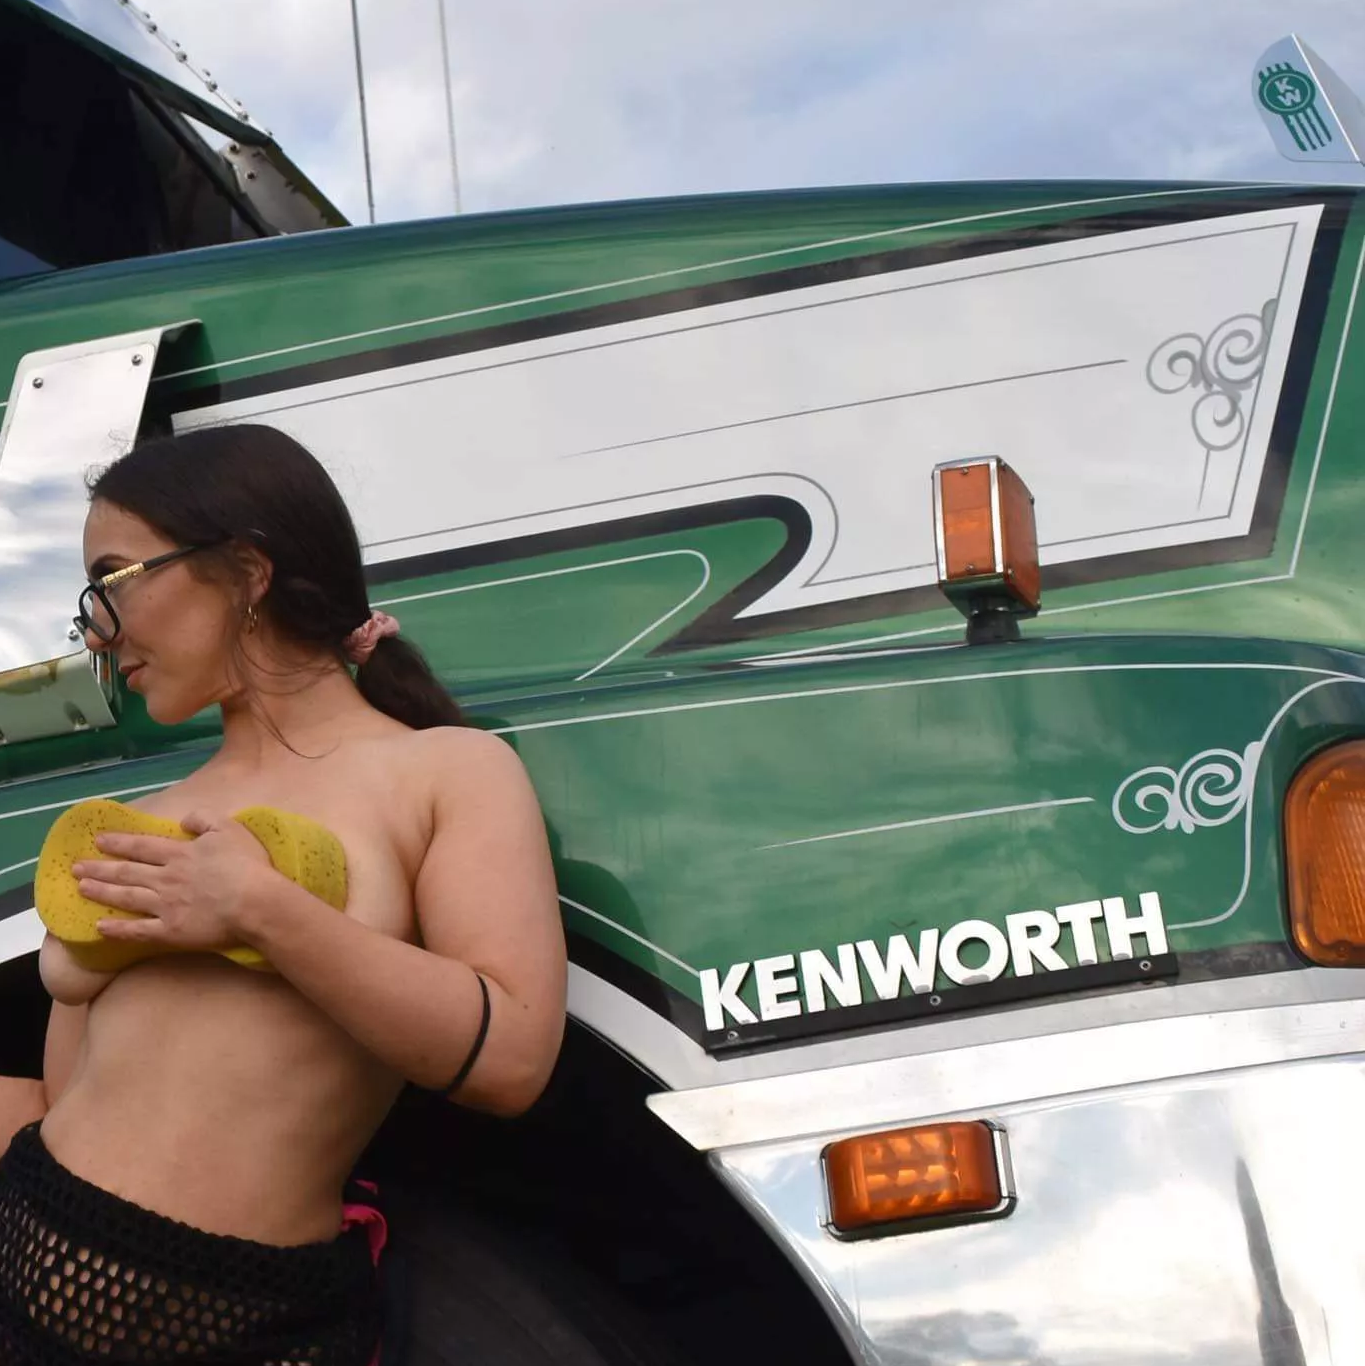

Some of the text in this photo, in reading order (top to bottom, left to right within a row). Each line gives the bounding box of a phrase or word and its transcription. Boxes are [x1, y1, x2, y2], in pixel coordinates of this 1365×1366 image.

[1275, 77, 1295, 94] K
[1277, 88, 1302, 106] W
[698, 891, 1171, 1032] KENWORTH
